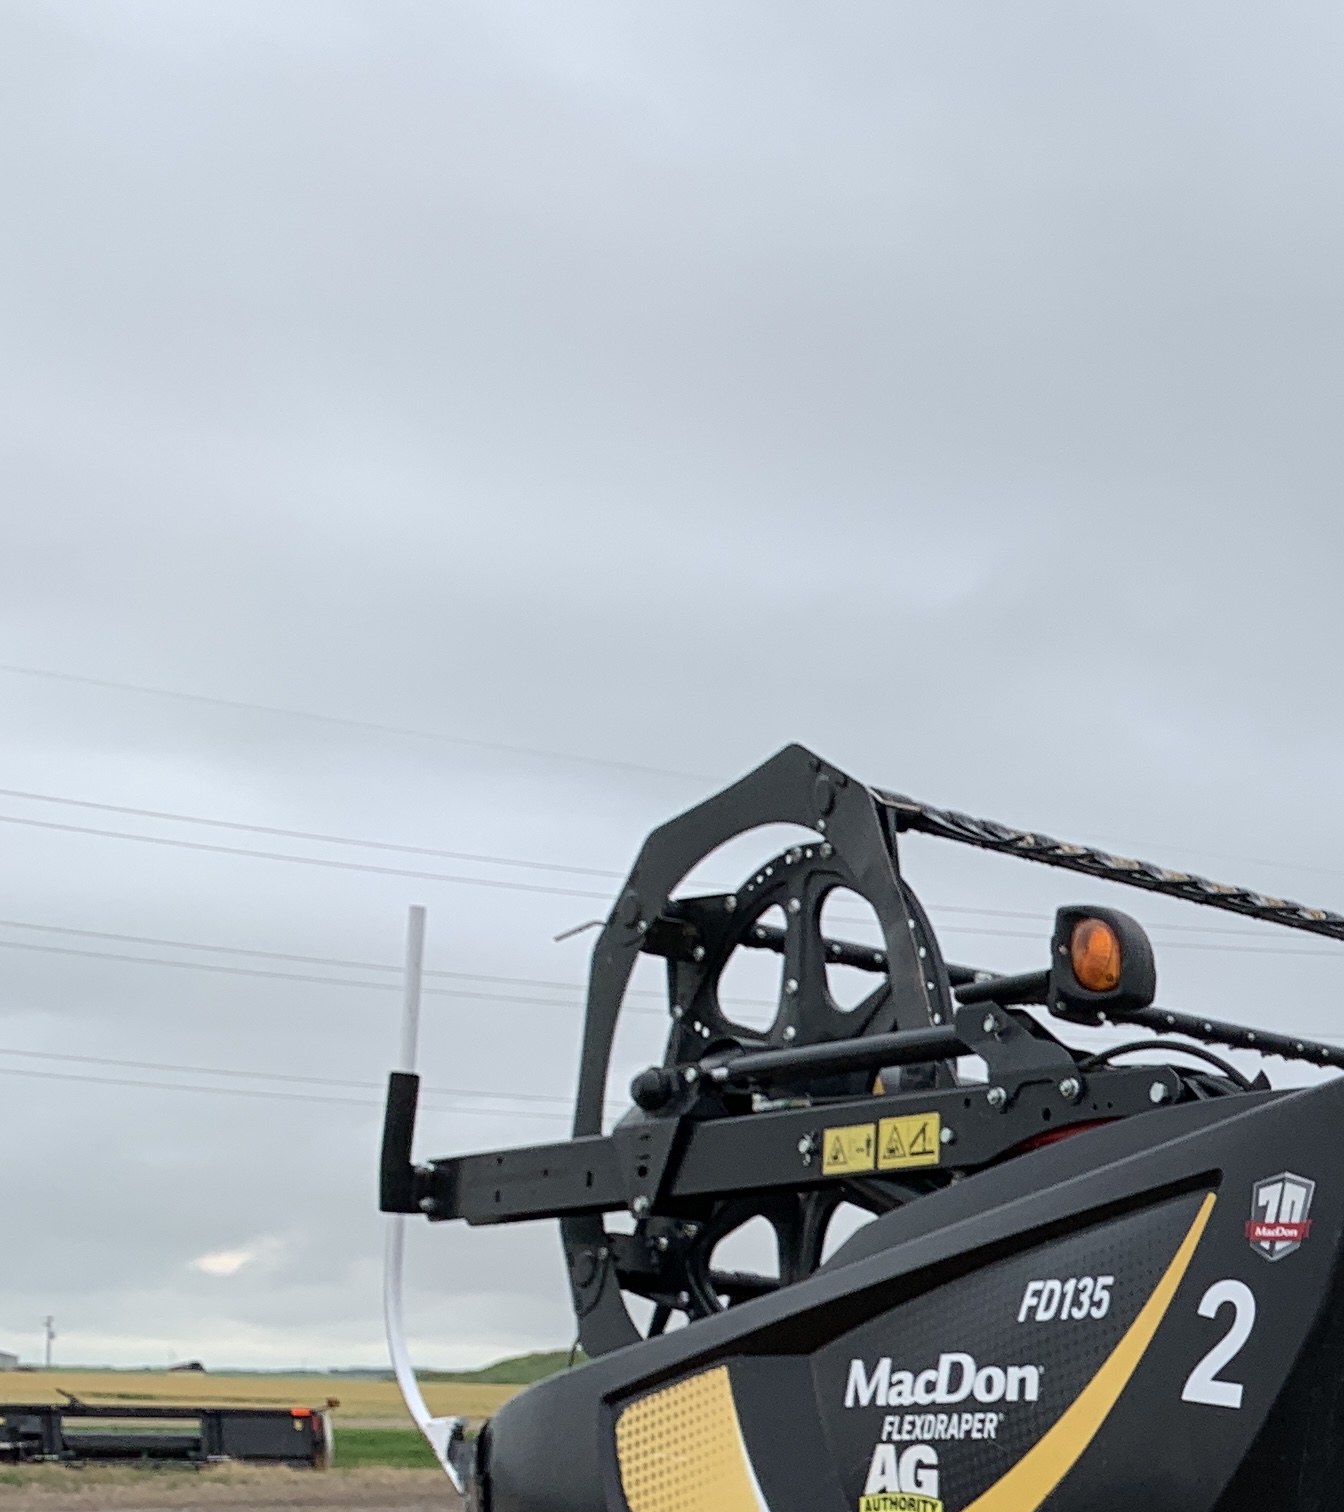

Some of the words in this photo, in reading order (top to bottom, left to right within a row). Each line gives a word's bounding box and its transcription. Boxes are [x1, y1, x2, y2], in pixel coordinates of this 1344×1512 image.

[1254, 1225, 1299, 1238] MacDon
[1017, 1275, 1115, 1323] FD135
[1181, 1279, 1256, 1409] 2
[844, 1352, 1041, 1408] MacDon
[881, 1412, 999, 1442] FLEXDRAPER
[864, 1443, 939, 1499] AG
